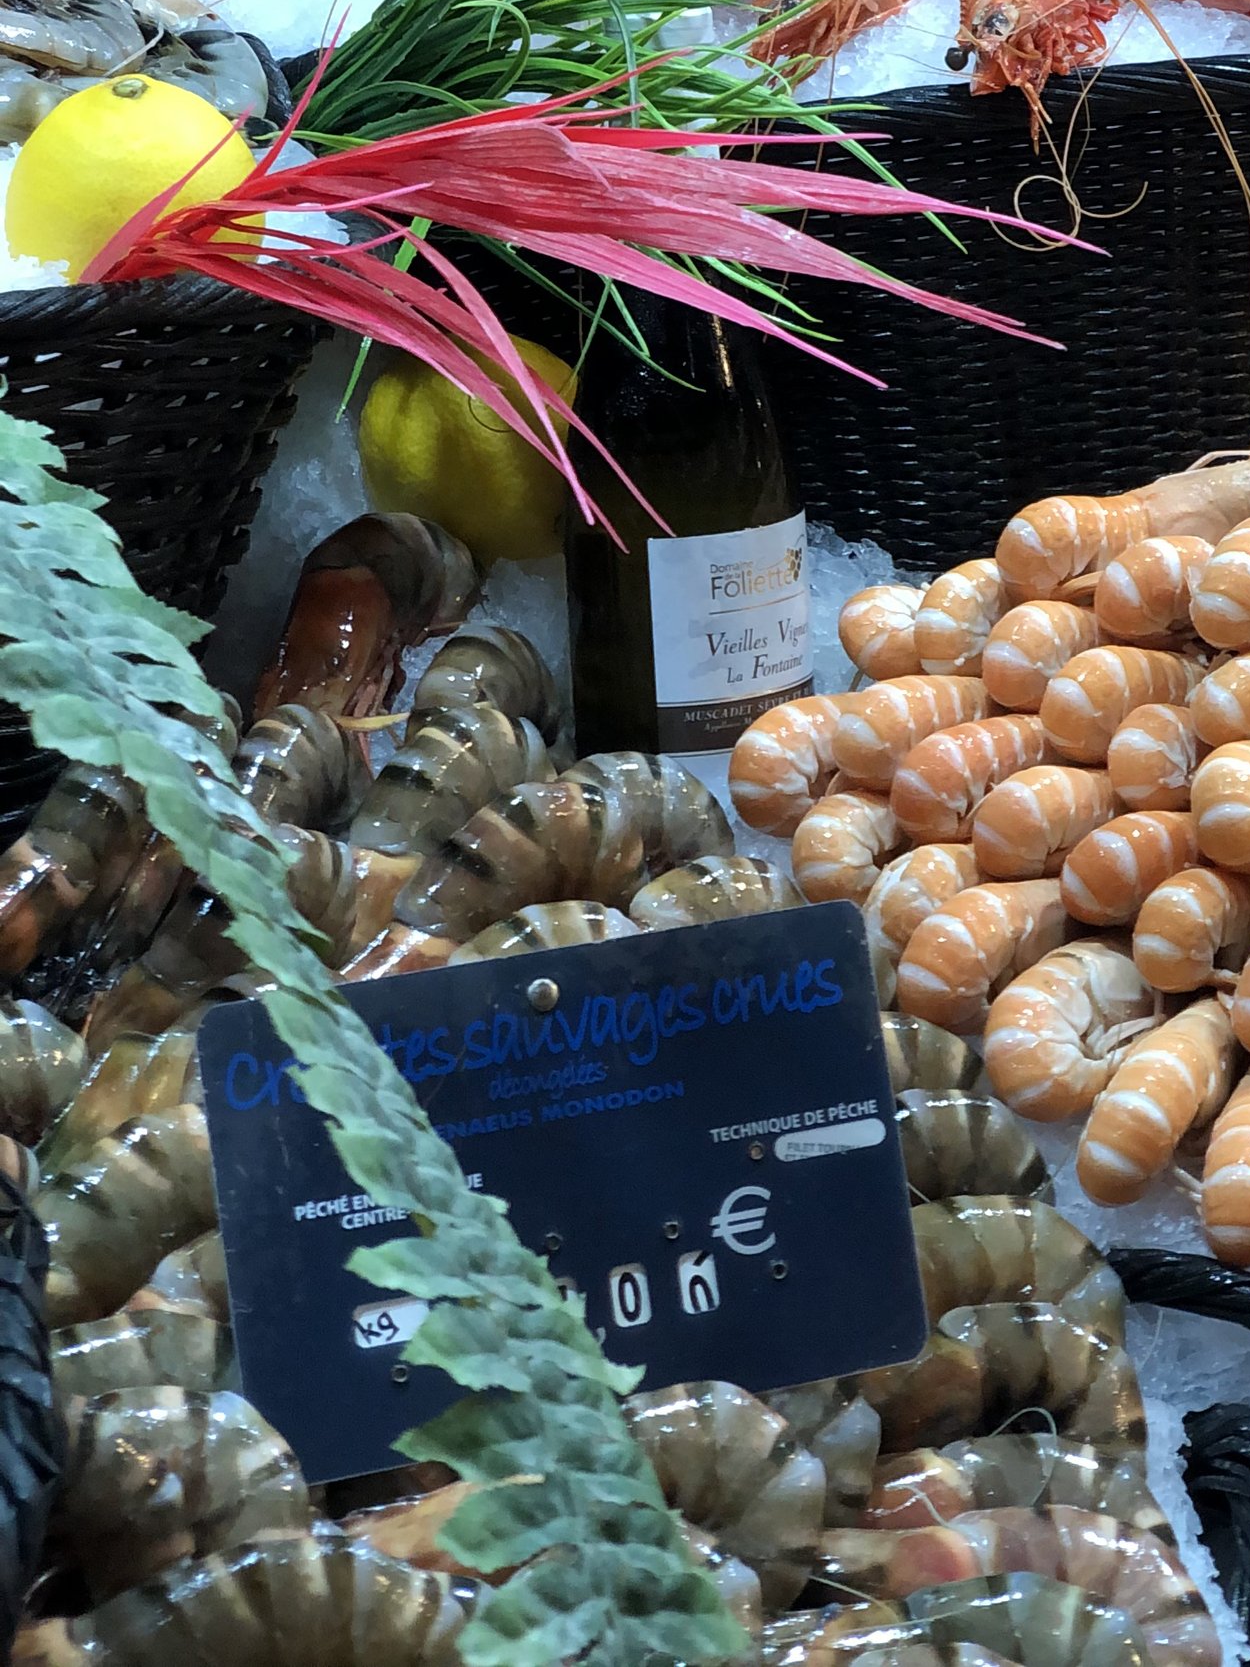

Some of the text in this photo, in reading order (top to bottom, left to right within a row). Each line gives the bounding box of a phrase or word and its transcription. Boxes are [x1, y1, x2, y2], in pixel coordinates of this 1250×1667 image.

[710, 560, 754, 574] Domaine
[710, 566, 793, 601] Foliette
[706, 627, 769, 657] Vieilles
[727, 653, 804, 685] La Fontaine
[683, 704, 753, 723] MUSCADET
[463, 983, 707, 1067] sauvages
[713, 958, 844, 1027] crues
[540, 1079, 686, 1122] MONODON
[709, 1099, 879, 1143] TECHNIQUE DE PÊCHE
[293, 1193, 376, 1222] PÊCHÉ EN
